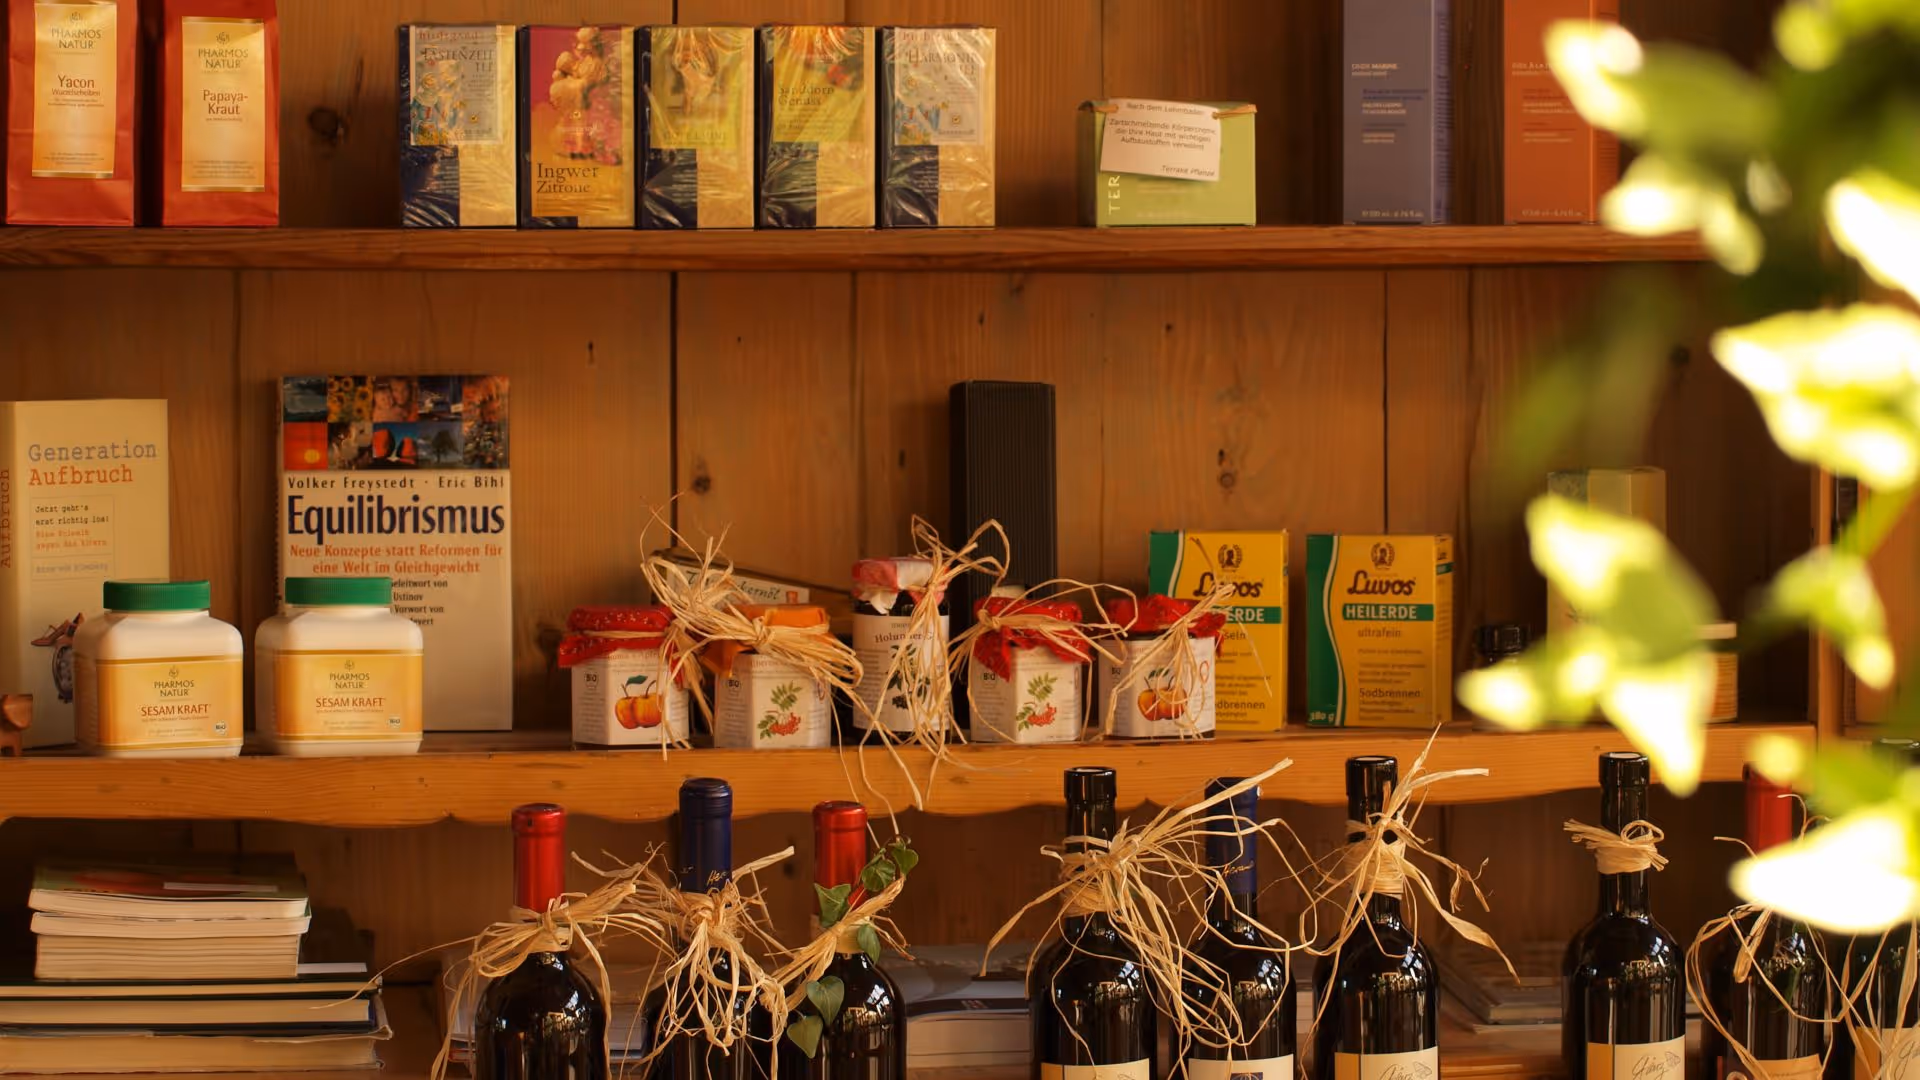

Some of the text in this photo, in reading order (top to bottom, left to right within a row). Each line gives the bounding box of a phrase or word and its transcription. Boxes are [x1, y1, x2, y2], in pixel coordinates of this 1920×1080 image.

[51, 28, 102, 39] PHARMOS
[58, 39, 95, 49] NATUR
[198, 48, 249, 58] PHARMOS
[205, 59, 241, 69] NATUR
[57, 74, 95, 88] Yacon
[203, 89, 249, 104] Papaya-
[208, 102, 241, 115] Kraut
[537, 162, 600, 184] Ingwer
[536, 180, 592, 193] Zitrone
[28, 440, 157, 462] Generation
[28, 464, 134, 485] Aufbruch
[288, 476, 504, 491] Volker Freystedt Eric Bihl
[35, 505, 59, 513] Jetzt
[58, 516, 89, 525] richtig
[288, 494, 505, 545] Equilibrismus
[290, 544, 503, 560] Neue Konzepte statt Reformen für
[312, 561, 481, 576] eine Welt im Gleichgewicht
[432, 580, 448, 588] von
[1346, 569, 1416, 596] Luvos
[393, 592, 424, 601] Ustinov
[394, 604, 444, 613] Vorwort von
[1346, 604, 1417, 620] HEILERDE
[1225, 608, 1265, 622] ERDE
[1224, 631, 1246, 640] seln
[1358, 626, 1401, 638] ultrafein
[329, 672, 370, 681] PHARMOS
[153, 679, 195, 688] PHARMOS
[335, 681, 365, 689] NATUR
[160, 688, 189, 697] NATUR
[1359, 688, 1420, 698] Sodbrennen
[315, 697, 383, 708] SESAM KRAFT
[1215, 700, 1265, 710] dbrennen
[141, 703, 209, 717] SESAM KRAFT
